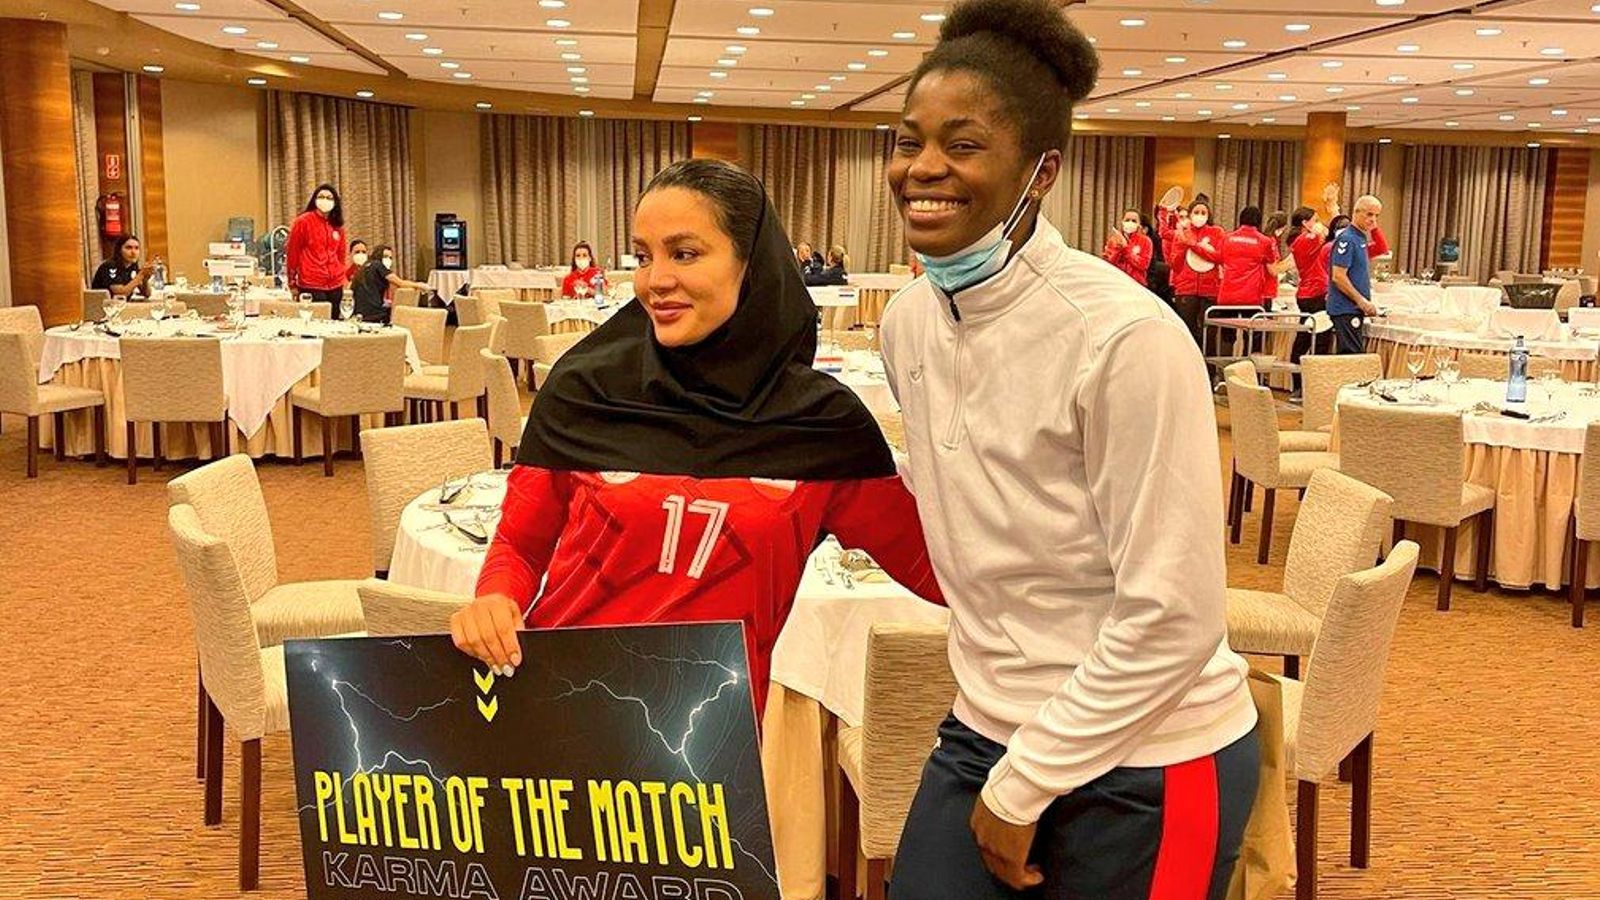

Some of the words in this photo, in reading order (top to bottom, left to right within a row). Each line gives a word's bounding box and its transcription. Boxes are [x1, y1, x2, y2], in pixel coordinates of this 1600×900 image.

[658, 494, 729, 579] 17
[314, 771, 441, 849] PLAYER
[446, 775, 488, 853] OF
[501, 777, 583, 859] THE
[587, 779, 734, 868] MATCH
[323, 850, 499, 900] KARMA
[519, 866, 743, 900] AWARD
